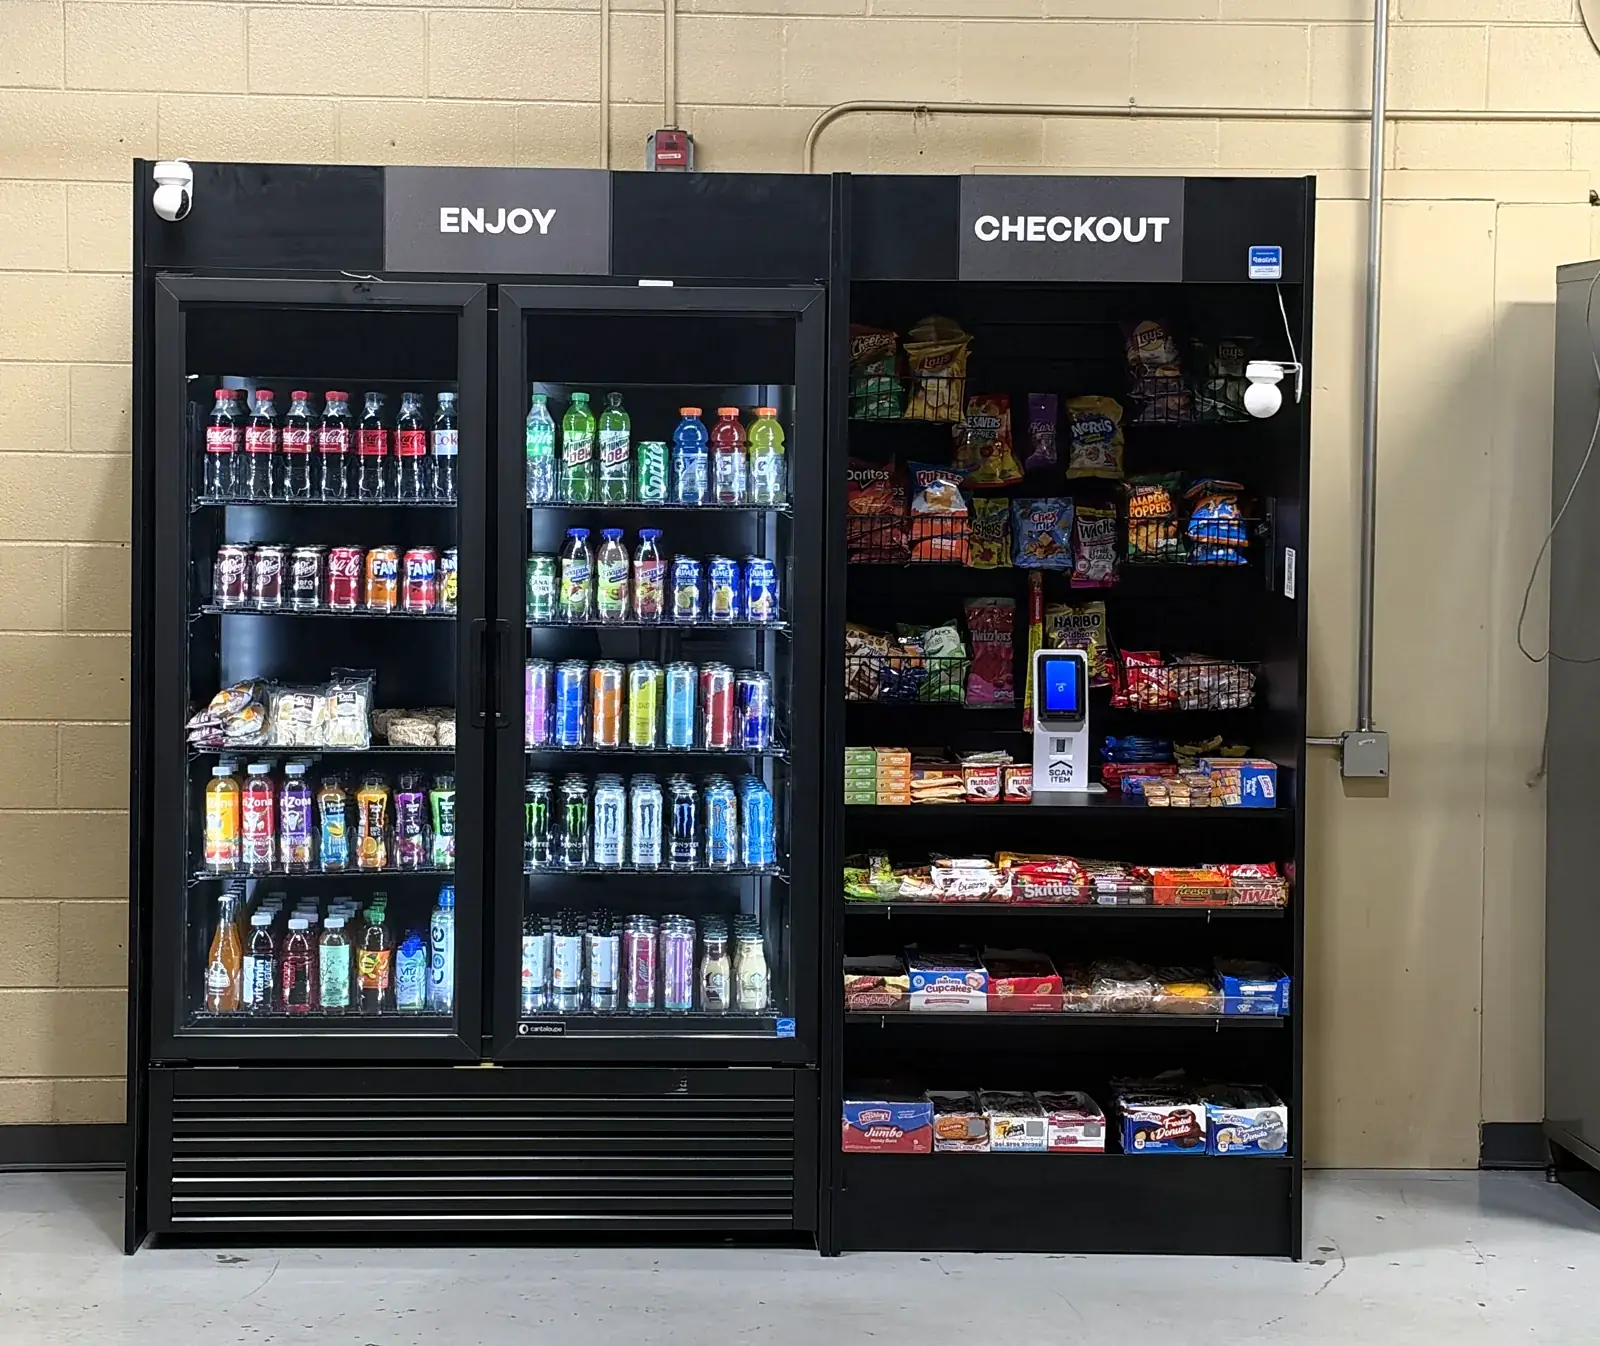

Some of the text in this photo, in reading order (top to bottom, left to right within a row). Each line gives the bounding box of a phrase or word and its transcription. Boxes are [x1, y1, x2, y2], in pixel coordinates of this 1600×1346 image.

[440, 207, 557, 235] ENJOY
[973, 214, 1171, 243] CHECKOUT
[851, 334, 893, 360] Cheetos
[434, 432, 458, 446] Cok
[646, 443, 663, 499] Sprite
[847, 468, 890, 481] Doritos
[1129, 501, 1172, 518] POPPERS
[1053, 614, 1101, 628] HARIBO
[1057, 629, 1100, 639] Goldbears
[1048, 768, 1073, 777] SCAN
[970, 777, 997, 786] nutella
[957, 881, 987, 892] bueno
[1023, 882, 1080, 898] Skittles
[253, 959, 265, 1003] vitamin
[937, 978, 961, 986] Hostess
[925, 984, 972, 995] Cupcakes
[1162, 1115, 1192, 1130] Frosted
[864, 1126, 903, 1138] Jumbo
[1155, 1125, 1191, 1140] Donuts
[1243, 1130, 1268, 1143] Donuts
